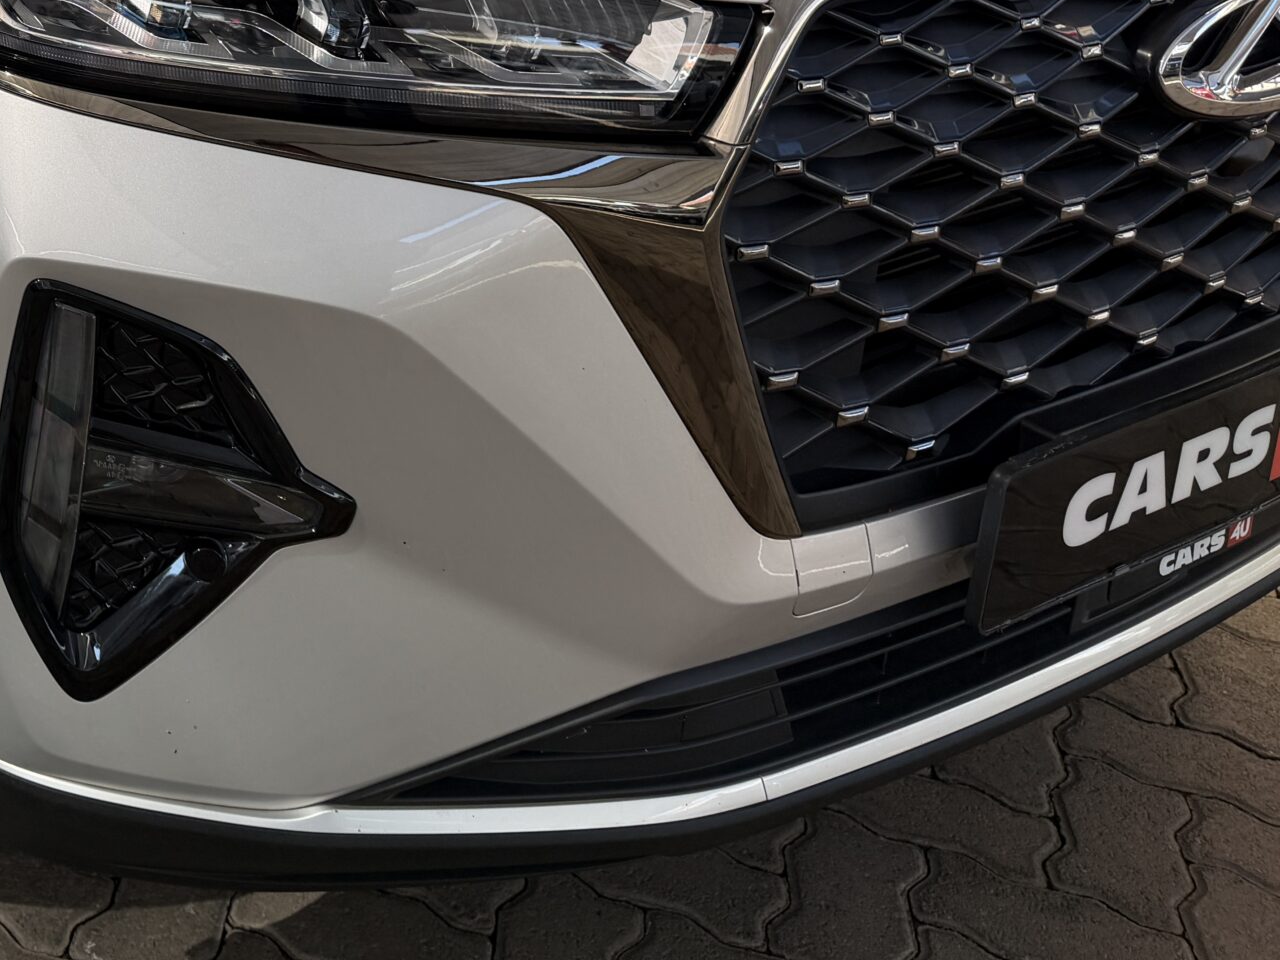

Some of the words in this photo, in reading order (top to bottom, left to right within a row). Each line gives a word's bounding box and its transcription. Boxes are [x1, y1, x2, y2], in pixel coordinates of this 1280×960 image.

[1062, 403, 1277, 547] CARS
[1158, 528, 1227, 577] CARS
[1229, 516, 1252, 541] 4U
